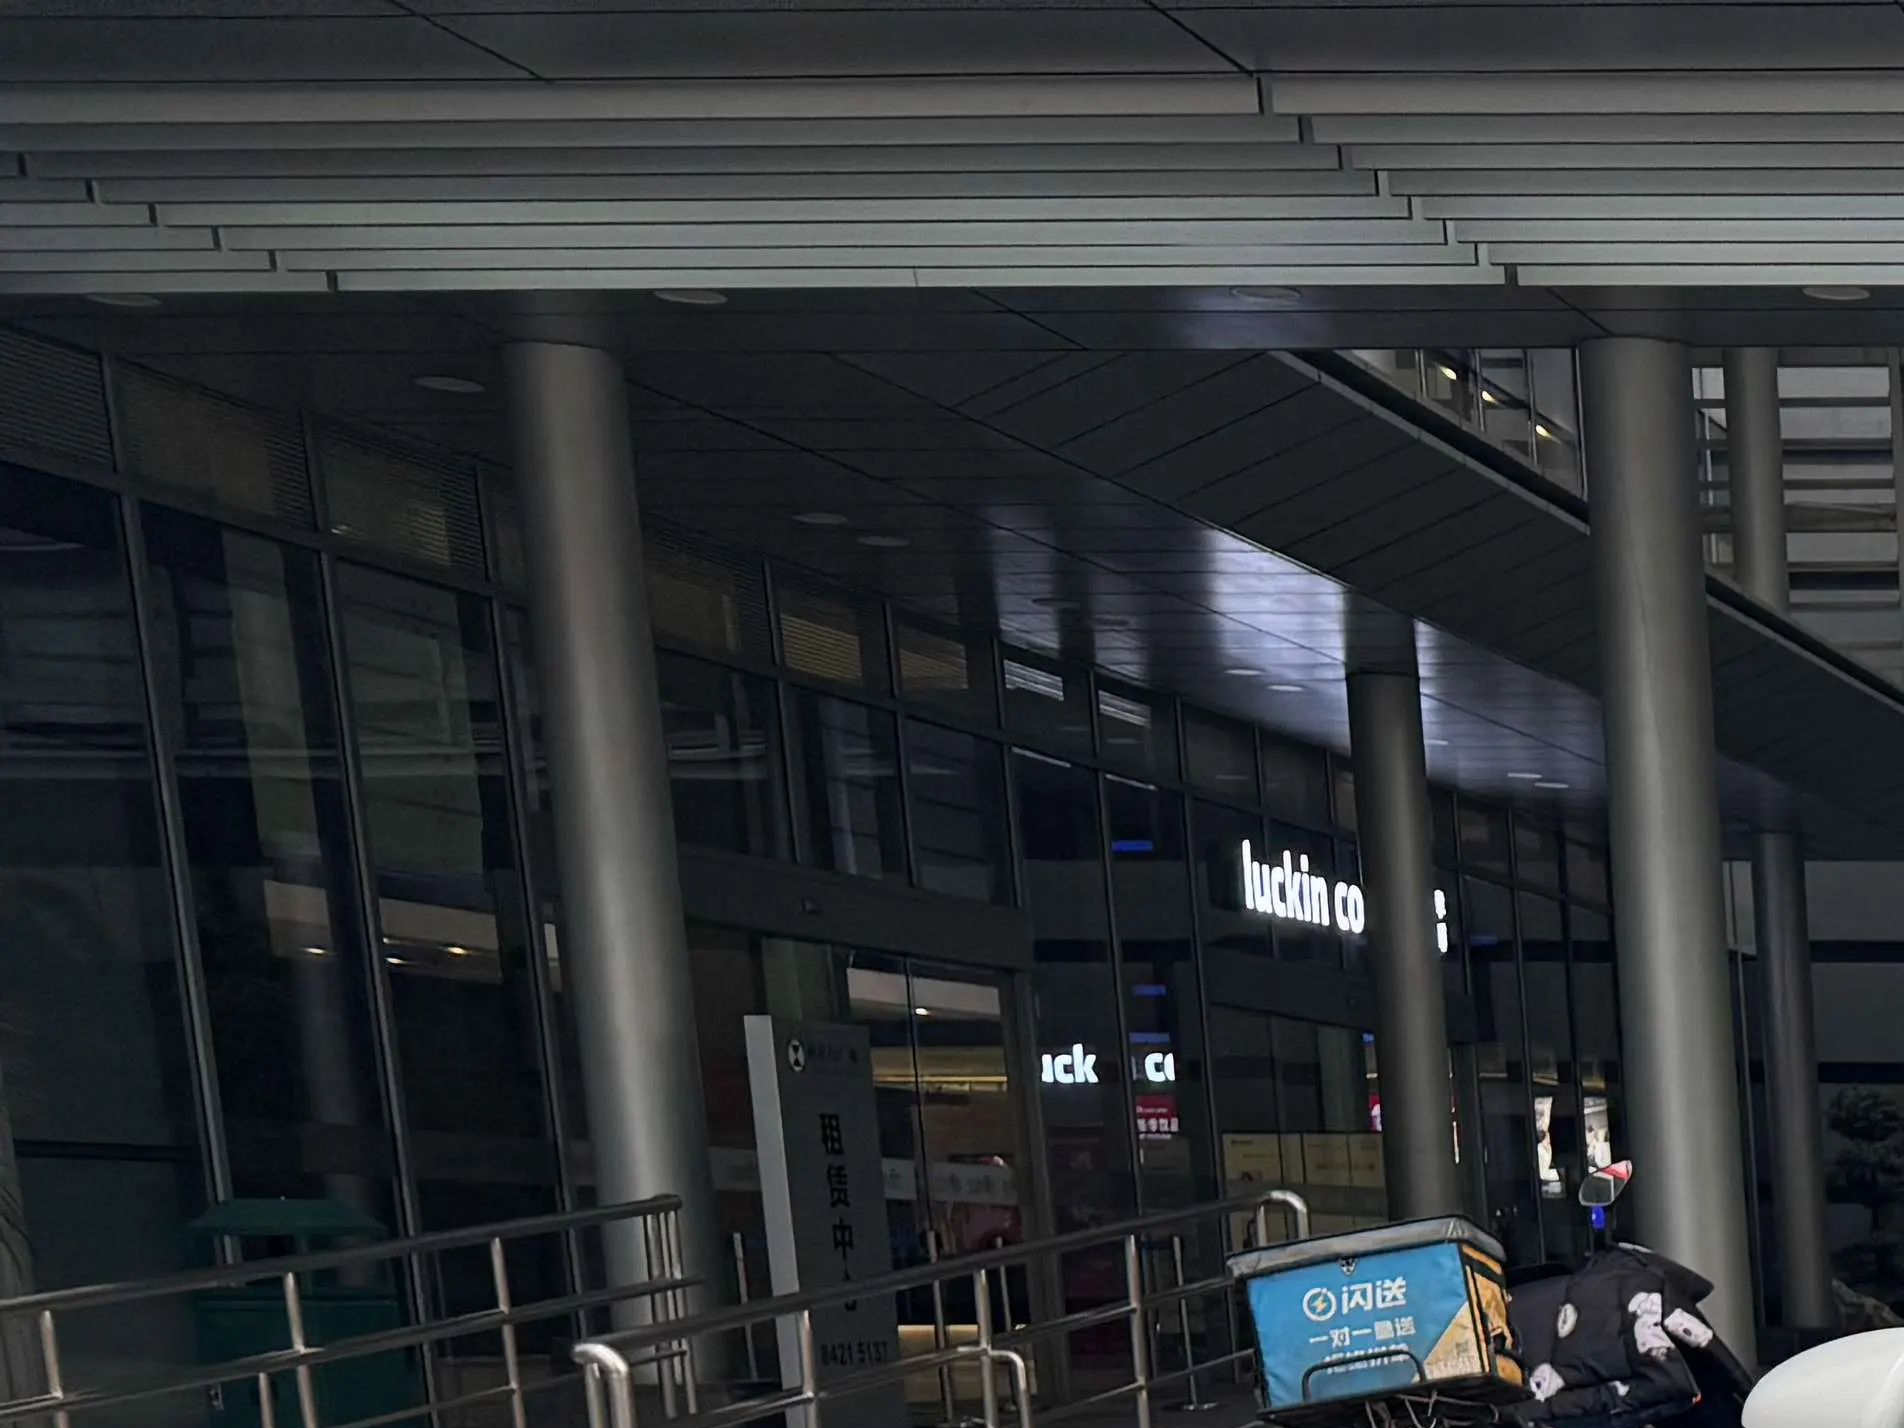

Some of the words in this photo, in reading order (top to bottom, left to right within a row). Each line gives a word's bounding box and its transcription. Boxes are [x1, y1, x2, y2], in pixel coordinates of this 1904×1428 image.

[1241, 839, 1330, 927] luckin
[1341, 1276, 1406, 1314] 闪送
[1309, 1316, 1416, 1348] 一对一送
